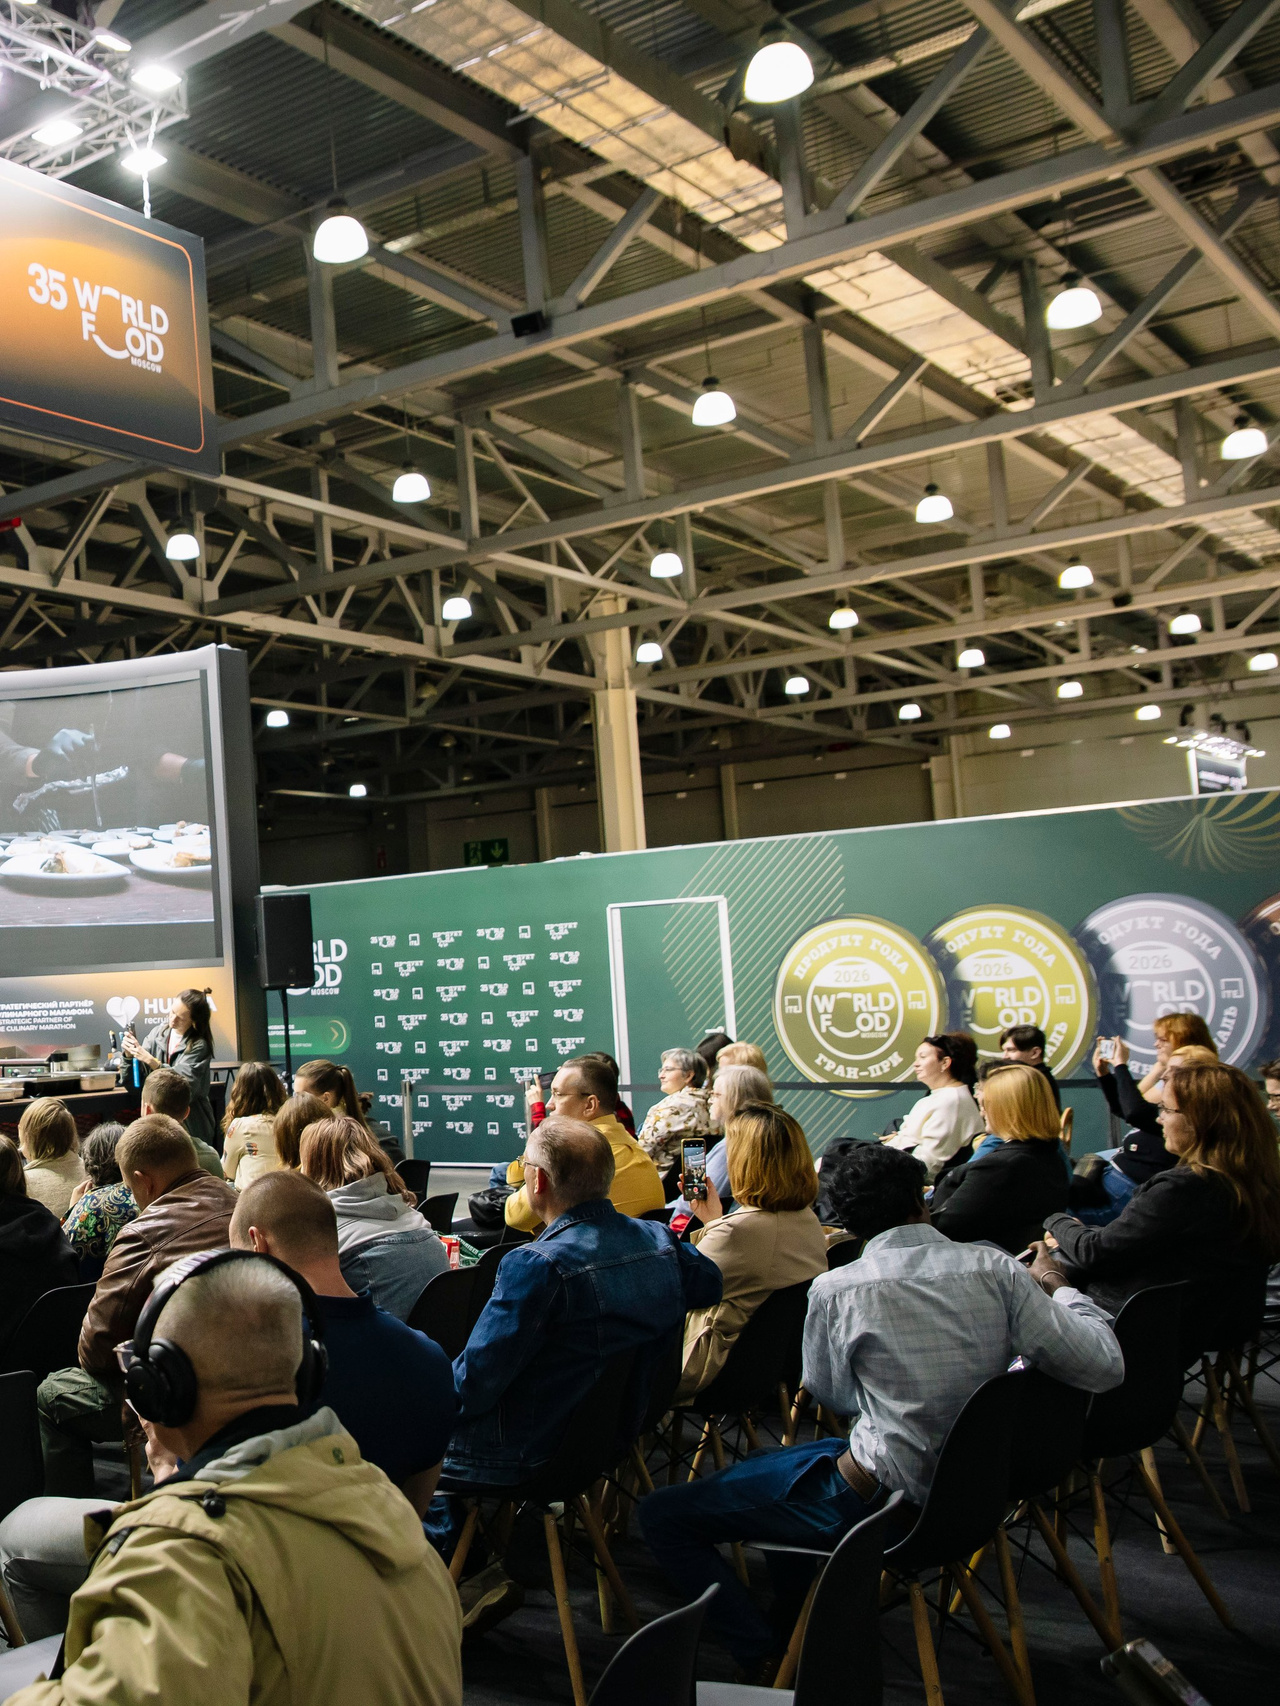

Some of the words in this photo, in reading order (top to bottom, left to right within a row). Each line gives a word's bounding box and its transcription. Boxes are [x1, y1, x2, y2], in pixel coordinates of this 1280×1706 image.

[27, 262, 68, 310] 35
[130, 356, 162, 374] MOSCOW
[1171, 920, 1222, 960] ГОДА
[1012, 929, 1057, 968] ГОДА
[793, 935, 864, 980] ПРОДУКТ
[869, 938, 910, 975] ГОДА
[1128, 954, 1172, 970] 2026
[834, 968, 870, 984] 2026
[973, 962, 1014, 977] 2026
[310, 987, 340, 996] MOSCOW
[59, 999, 94, 1009] ПАРТНЁР
[33, 1016, 63, 1024] PARTNER
[49, 1008, 94, 1017] МАРАФОНА
[6, 1024, 38, 1032] CULINARY
[814, 1051, 904, 1080] ГРАН-ПРИ
